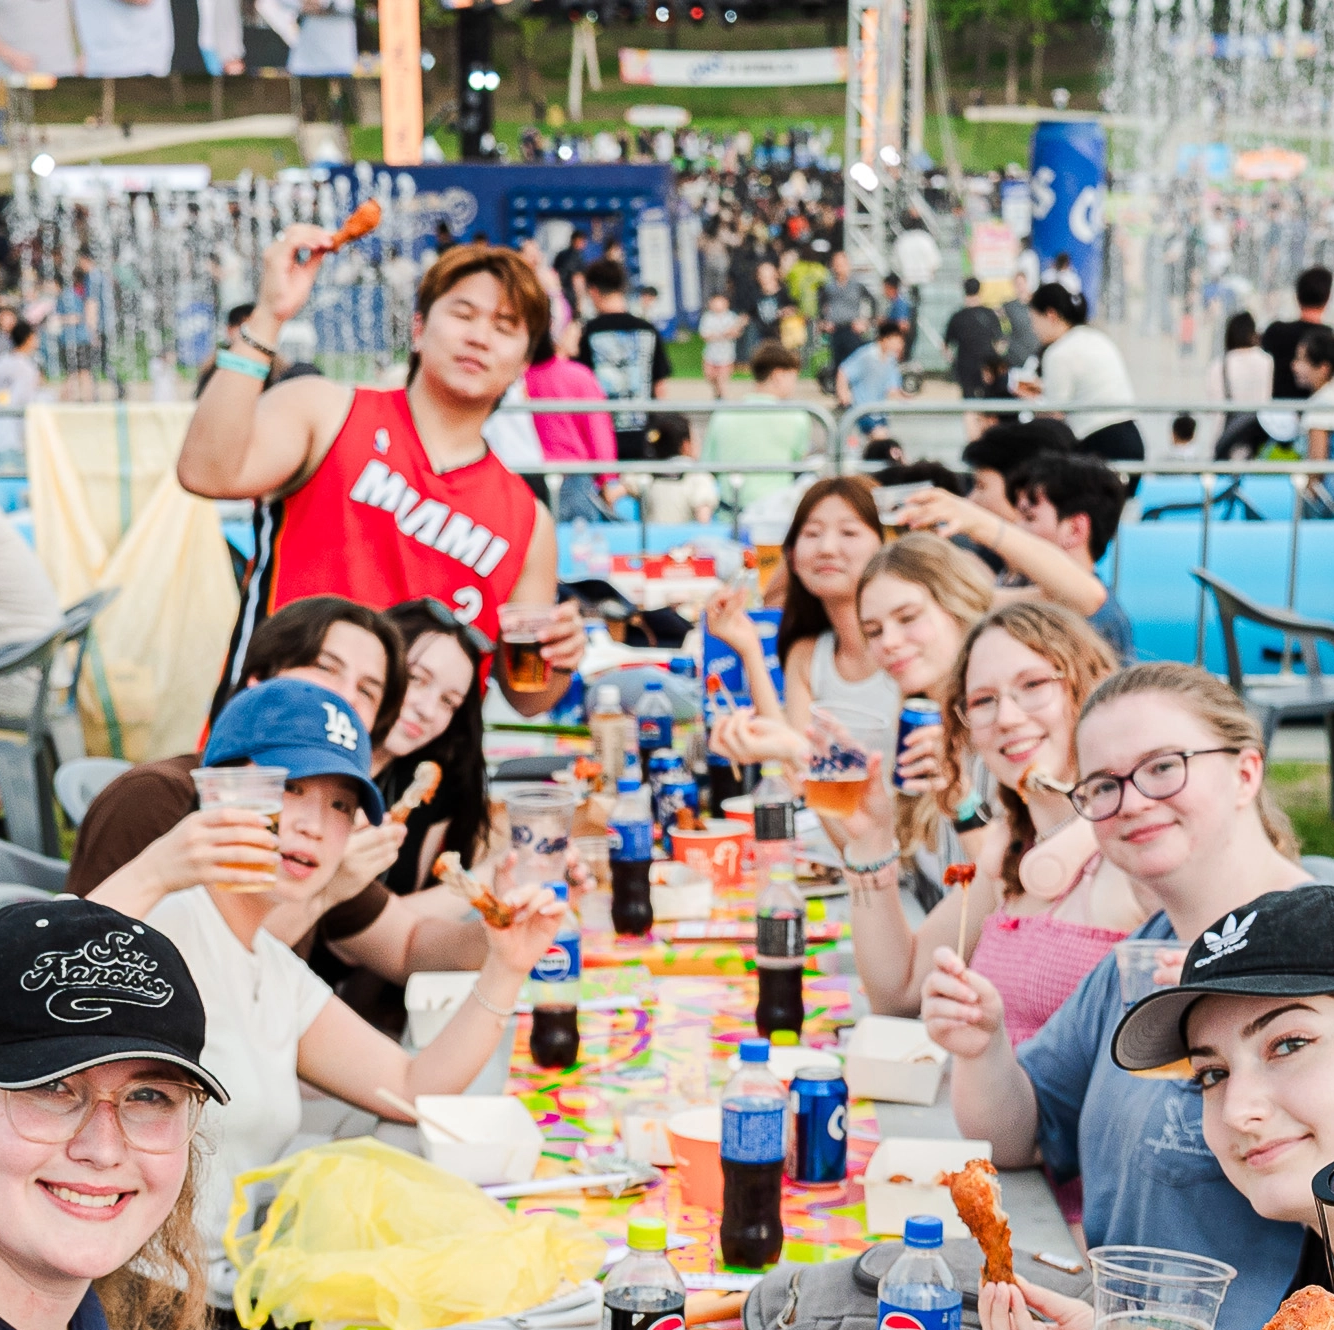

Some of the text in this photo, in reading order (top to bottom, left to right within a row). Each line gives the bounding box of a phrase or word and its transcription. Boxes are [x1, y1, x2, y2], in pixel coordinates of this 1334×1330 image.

[349, 458, 510, 578] MIAMI
[322, 702, 358, 751] LA
[84, 931, 158, 971] San
